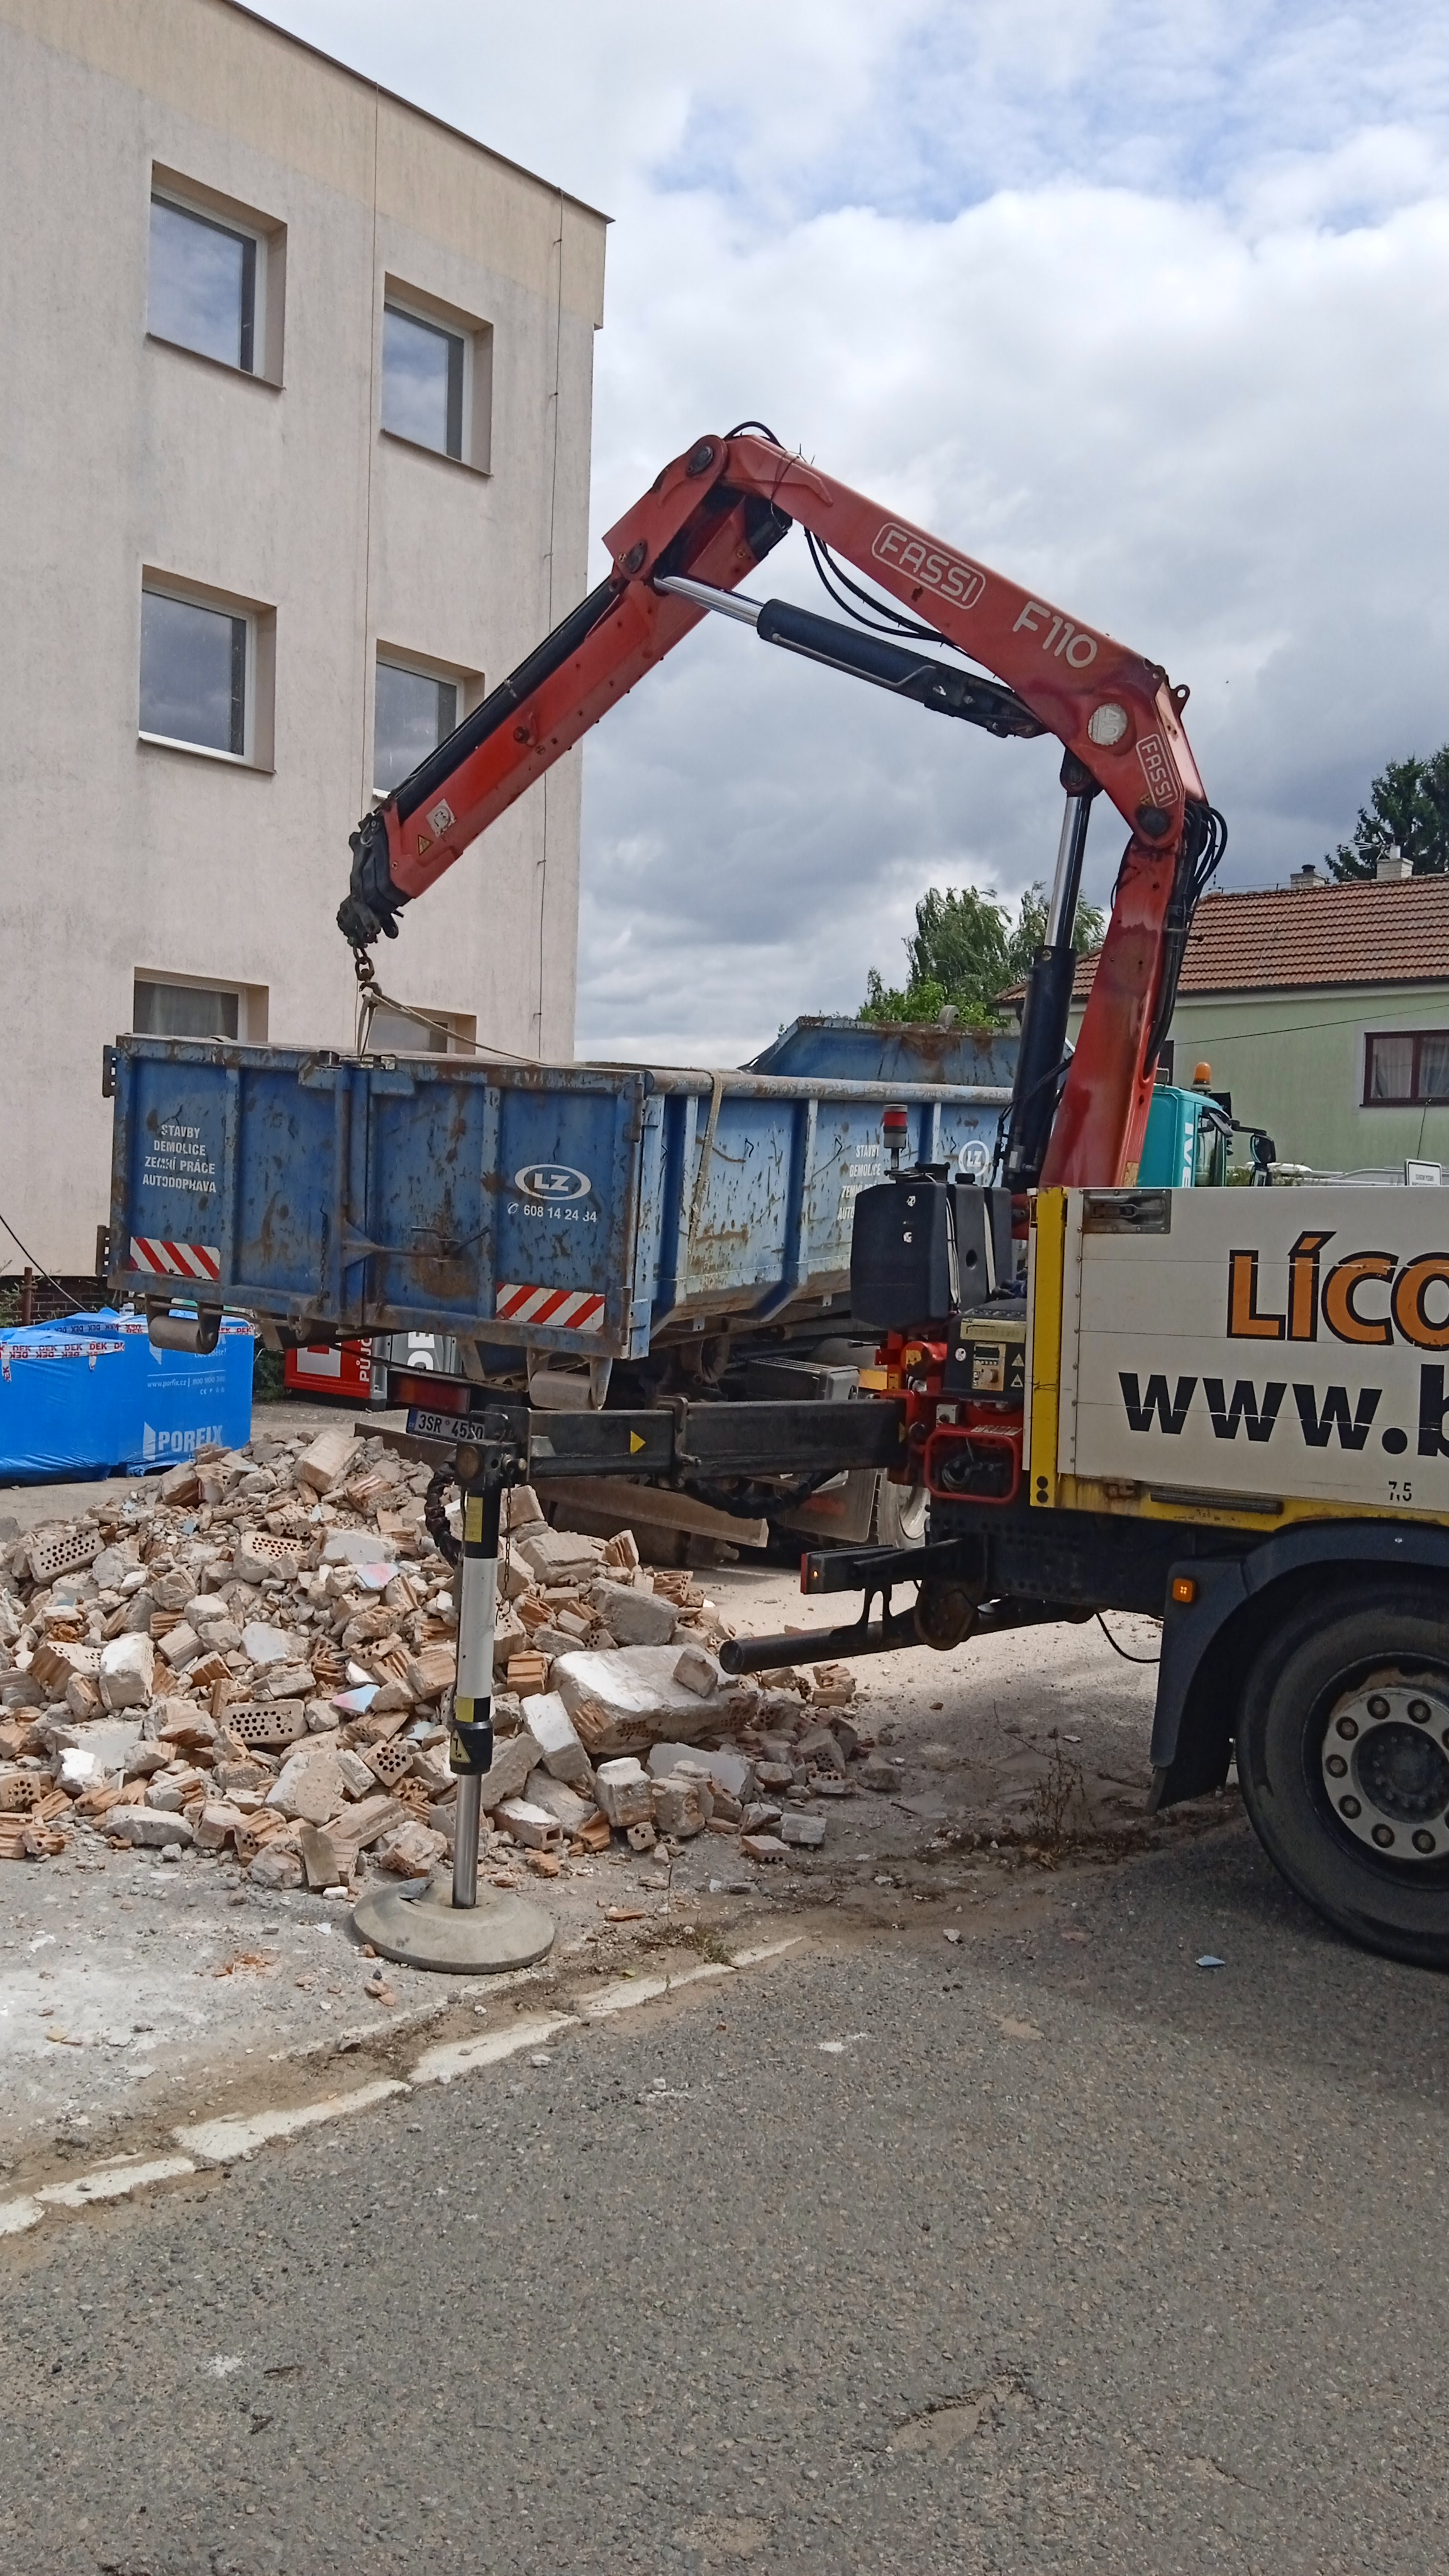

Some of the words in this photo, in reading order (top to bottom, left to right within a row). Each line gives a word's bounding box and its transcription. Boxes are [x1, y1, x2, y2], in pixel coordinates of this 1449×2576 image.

[879, 530, 977, 602] FASSI
[1012, 601, 1097, 668] F110
[1141, 740, 1174, 802] FASSI
[161, 1124, 201, 1139] STAVBY
[153, 1140, 206, 1156] DEMOLICE
[855, 1144, 880, 1158] STAVBY
[179, 1158, 216, 1174] PRÁCE
[967, 1150, 983, 1168] LZ
[849, 1163, 881, 1177] DEMOLICE
[142, 1174, 216, 1193] AUTODOPRAVA
[534, 1172, 571, 1191] LZ
[523, 1204, 543, 1218] 608
[548, 1207, 561, 1219] 14
[564, 1209, 579, 1221] 24
[582, 1211, 597, 1223] 34
[418, 1414, 442, 1433] 3SR
[158, 1424, 223, 1453] PORFIX
[1388, 1480, 1413, 1502] 7,5
